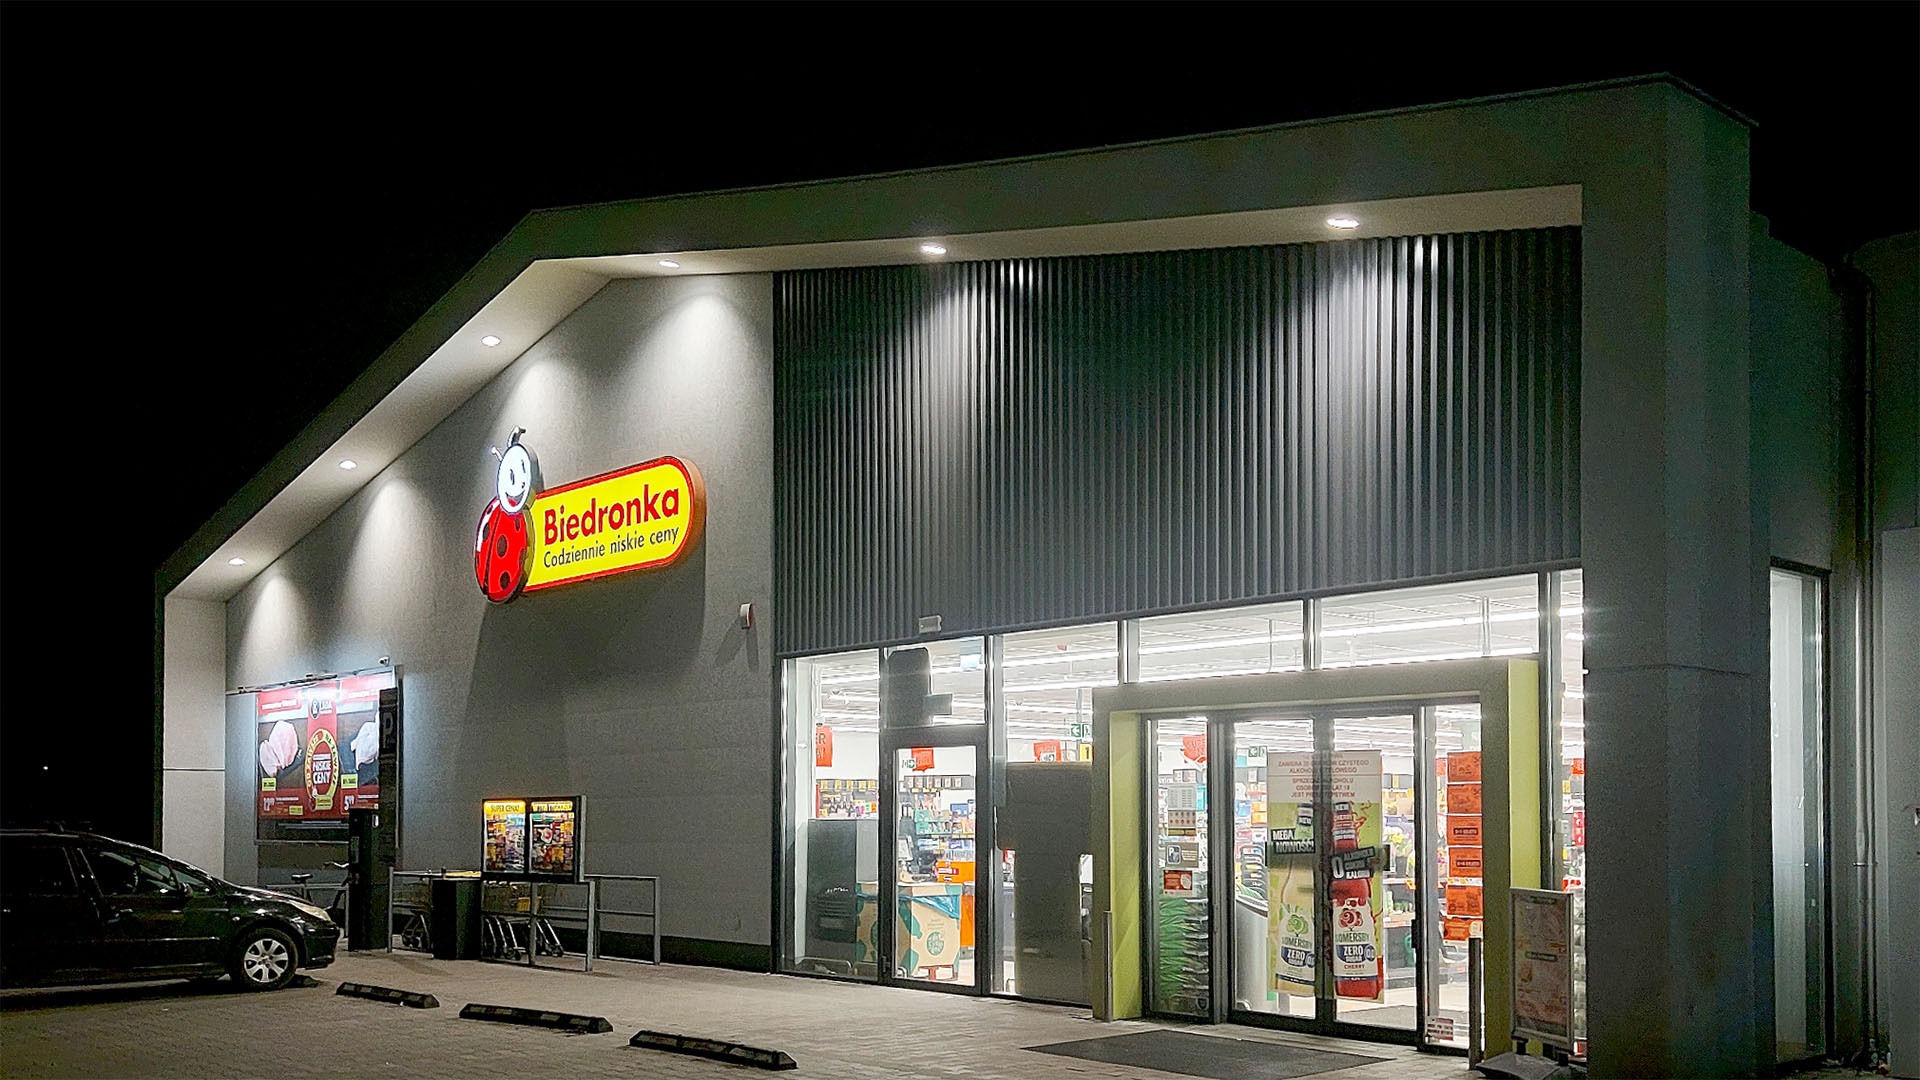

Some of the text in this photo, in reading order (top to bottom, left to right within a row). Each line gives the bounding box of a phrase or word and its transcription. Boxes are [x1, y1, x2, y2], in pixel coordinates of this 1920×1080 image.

[544, 483, 679, 546] Biedronka
[543, 526, 680, 568] Codziennie niskie ceny
[312, 771, 331, 784] CENY
[1272, 829, 1294, 841] MEGA
[1275, 839, 1314, 853] NOWOŚĆ!
[1331, 855, 1345, 879] 0
[1287, 948, 1305, 960] ZERO
[1343, 945, 1363, 956] ZERO
